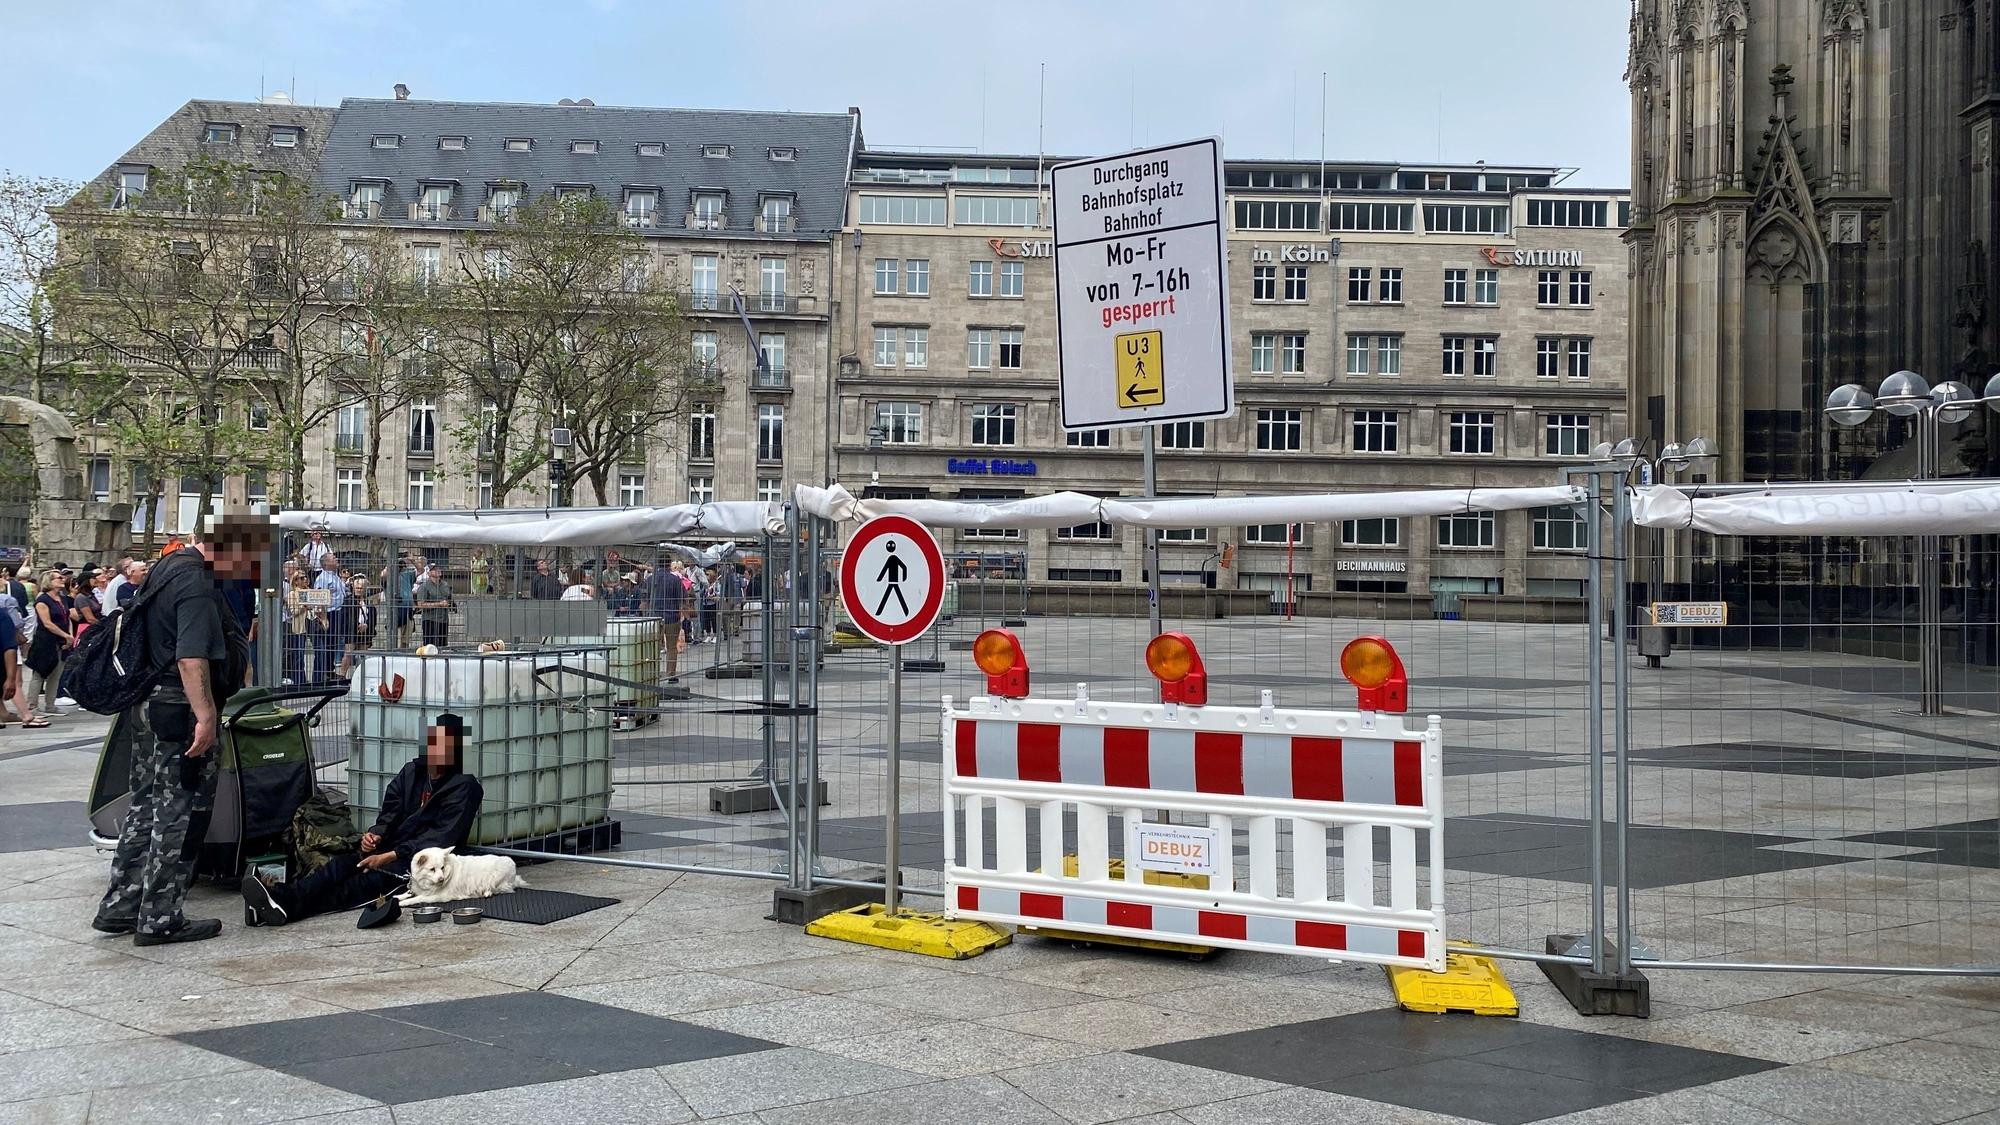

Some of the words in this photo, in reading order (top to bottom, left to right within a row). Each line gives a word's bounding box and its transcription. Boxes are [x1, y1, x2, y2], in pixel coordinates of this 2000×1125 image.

[1094, 160, 1169, 185] Durchgang
[1082, 181, 1183, 212] Bahnhofsplatz
[1104, 207, 1162, 233] Bahnhof
[1107, 238, 1167, 267] Mo-Fr
[1253, 244, 1272, 262] in
[1281, 244, 1329, 262] Köln
[1514, 248, 1582, 267] SATURN
[1087, 282, 1119, 302] von
[1102, 295, 1175, 328] gesperrt
[1337, 561, 1406, 572] DEICHMANNHAUS
[1681, 607, 1718, 615] DEBUZ
[1148, 841, 1202, 857] DEBUZ
[1425, 988, 1489, 1000] DEBUZ
